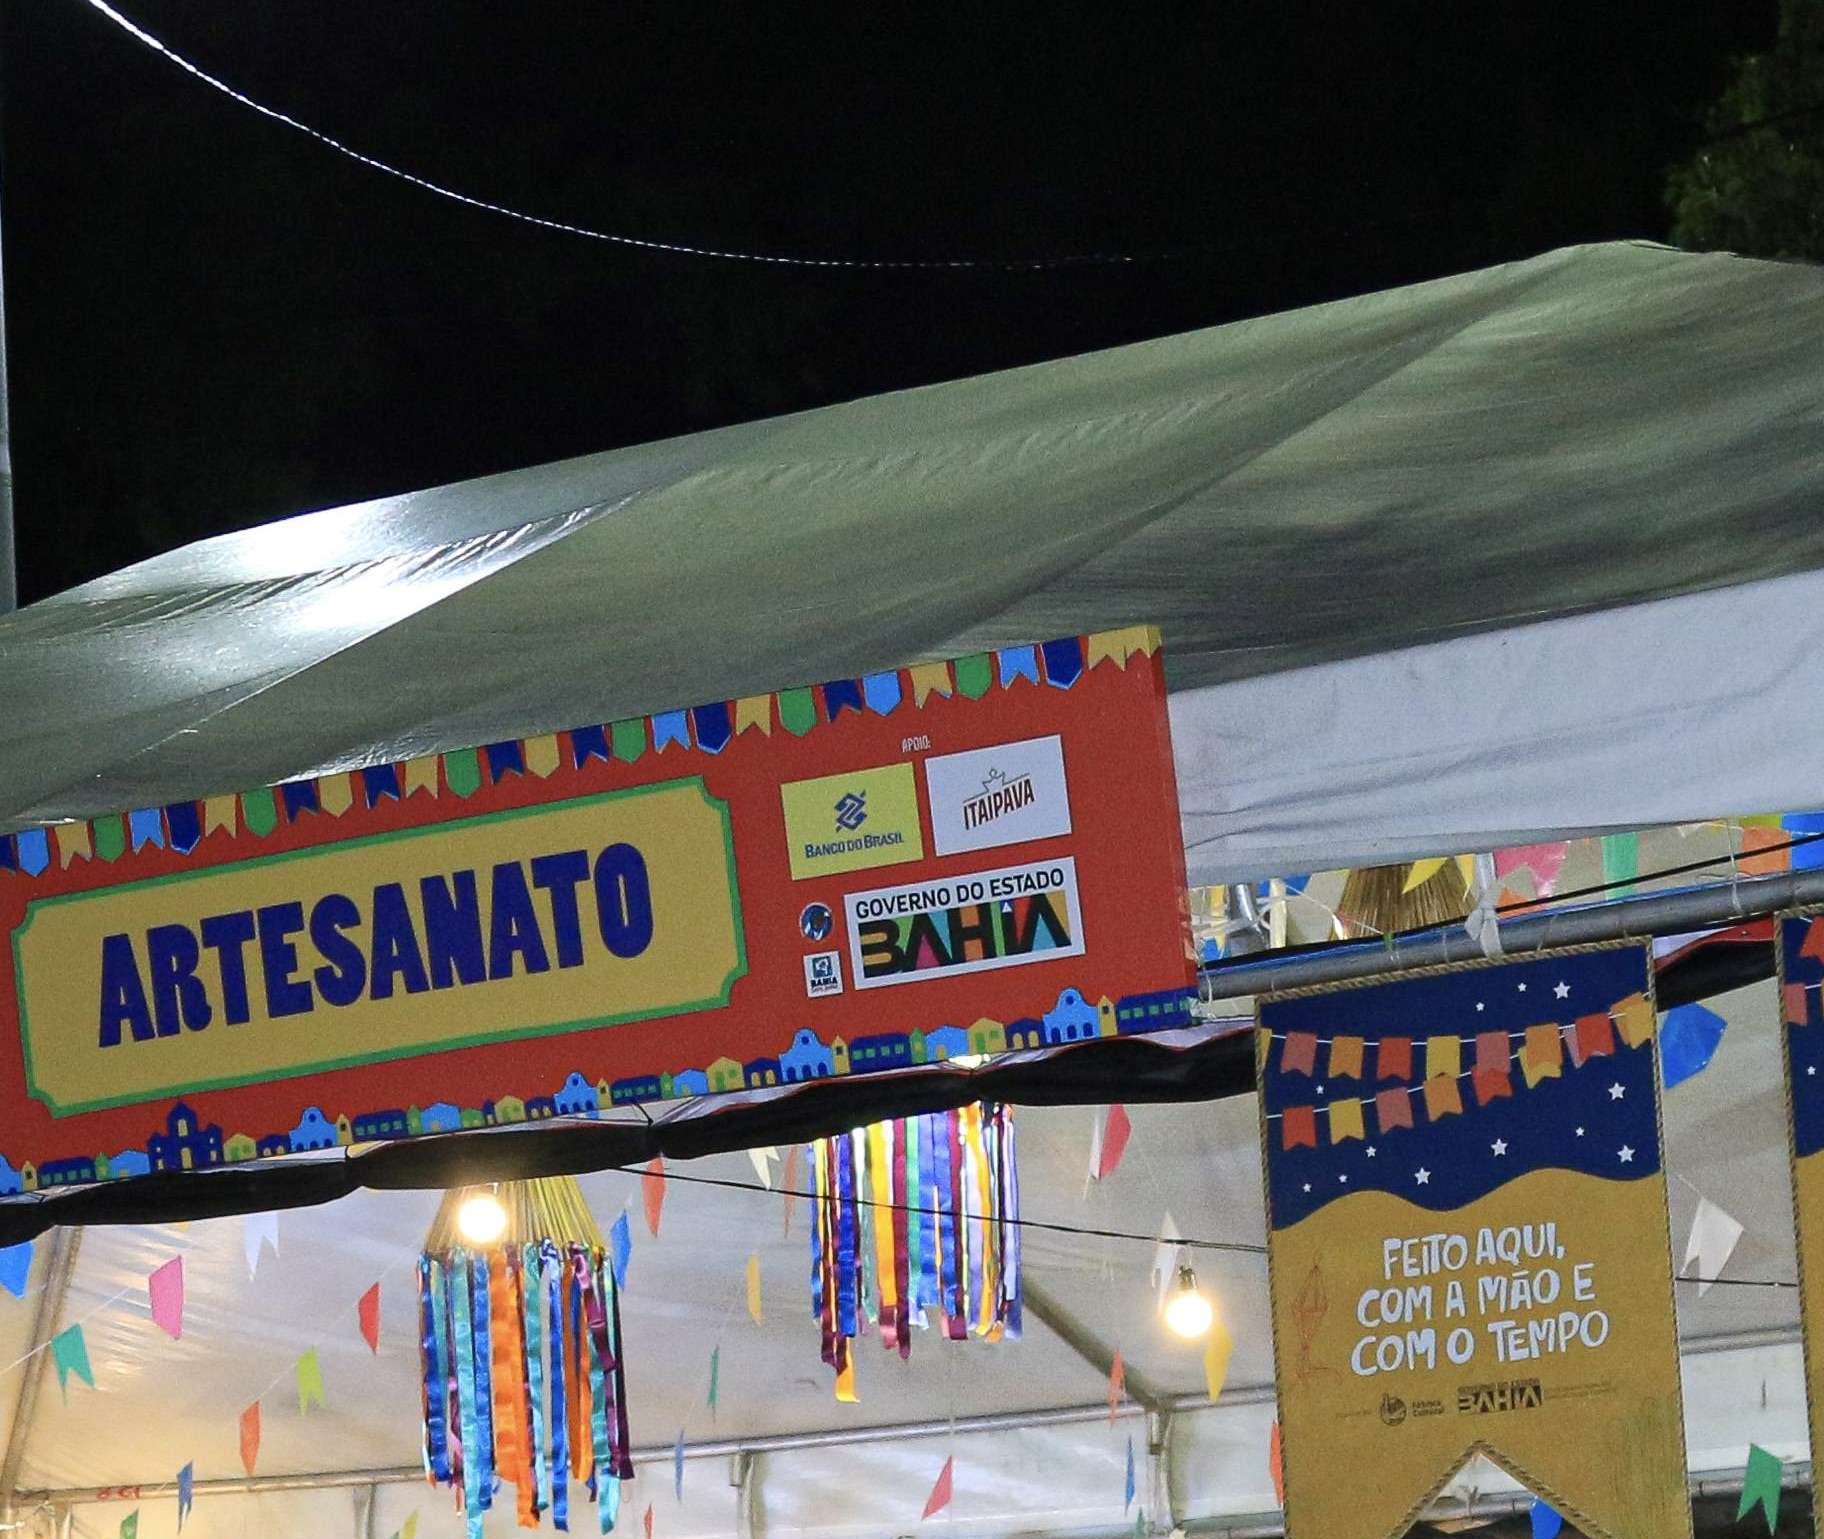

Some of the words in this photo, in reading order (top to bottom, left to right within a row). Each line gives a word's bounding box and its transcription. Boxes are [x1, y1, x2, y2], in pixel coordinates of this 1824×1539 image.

[902, 735, 931, 752] APOIO:
[963, 778, 1035, 830] ITAIPAVA
[805, 841, 845, 858] BANCO
[847, 839, 862, 852] DO
[864, 832, 904, 849] BRASIL
[856, 888, 951, 919] GOVERNO
[956, 882, 984, 902] DO
[991, 868, 1064, 897] ESTADO
[98, 842, 654, 1048] ARTESANATO
[1383, 1234, 1468, 1280] FEITO
[1475, 1222, 1565, 1265] AQUI,
[1357, 1285, 1432, 1327] COM
[1445, 1280, 1466, 1318] A
[1478, 1268, 1561, 1315] MÃO
[1573, 1262, 1596, 1301] E
[1351, 1328, 1436, 1376] COM
[1446, 1327, 1474, 1365] O
[1487, 1310, 1609, 1362] TEMPO
